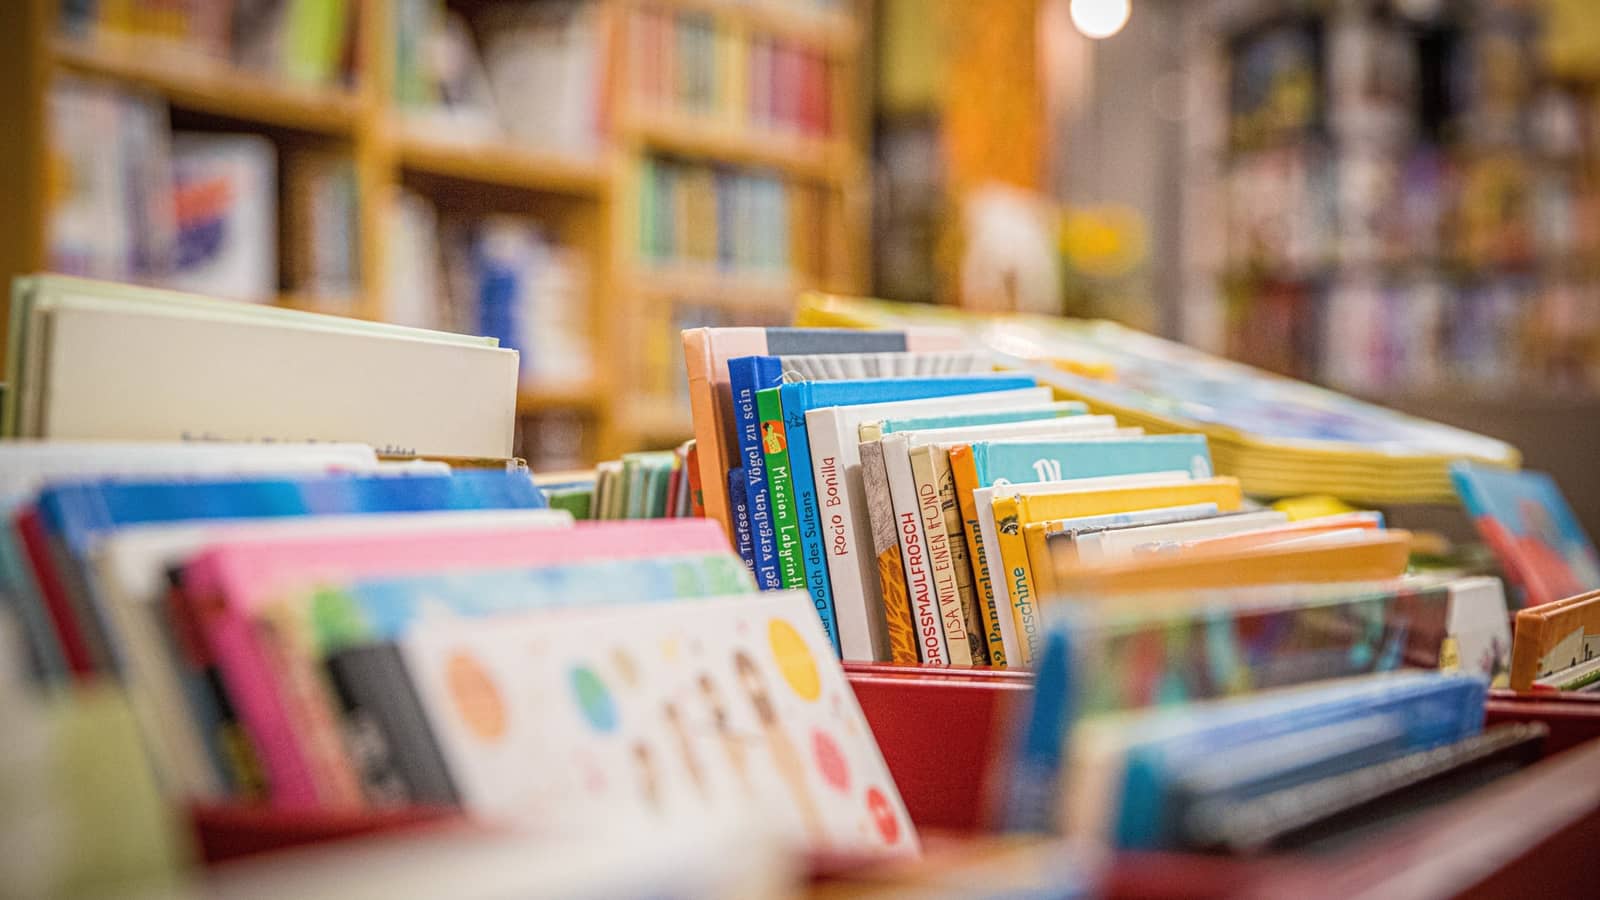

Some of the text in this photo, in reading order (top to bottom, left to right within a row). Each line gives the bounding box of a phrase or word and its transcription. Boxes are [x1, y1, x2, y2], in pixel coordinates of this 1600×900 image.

[739, 389, 780, 590] gel vergaßen, Vögel zu sein
[802, 490, 817, 538] Sultans
[820, 457, 848, 556] Rocio Bonilla
[737, 504, 752, 554] Tiefsee
[772, 466, 803, 591] Mission Labyrinth
[808, 542, 820, 566] des
[920, 483, 966, 640] LISA WILL EINEN HUND
[810, 570, 826, 610] Dolch
